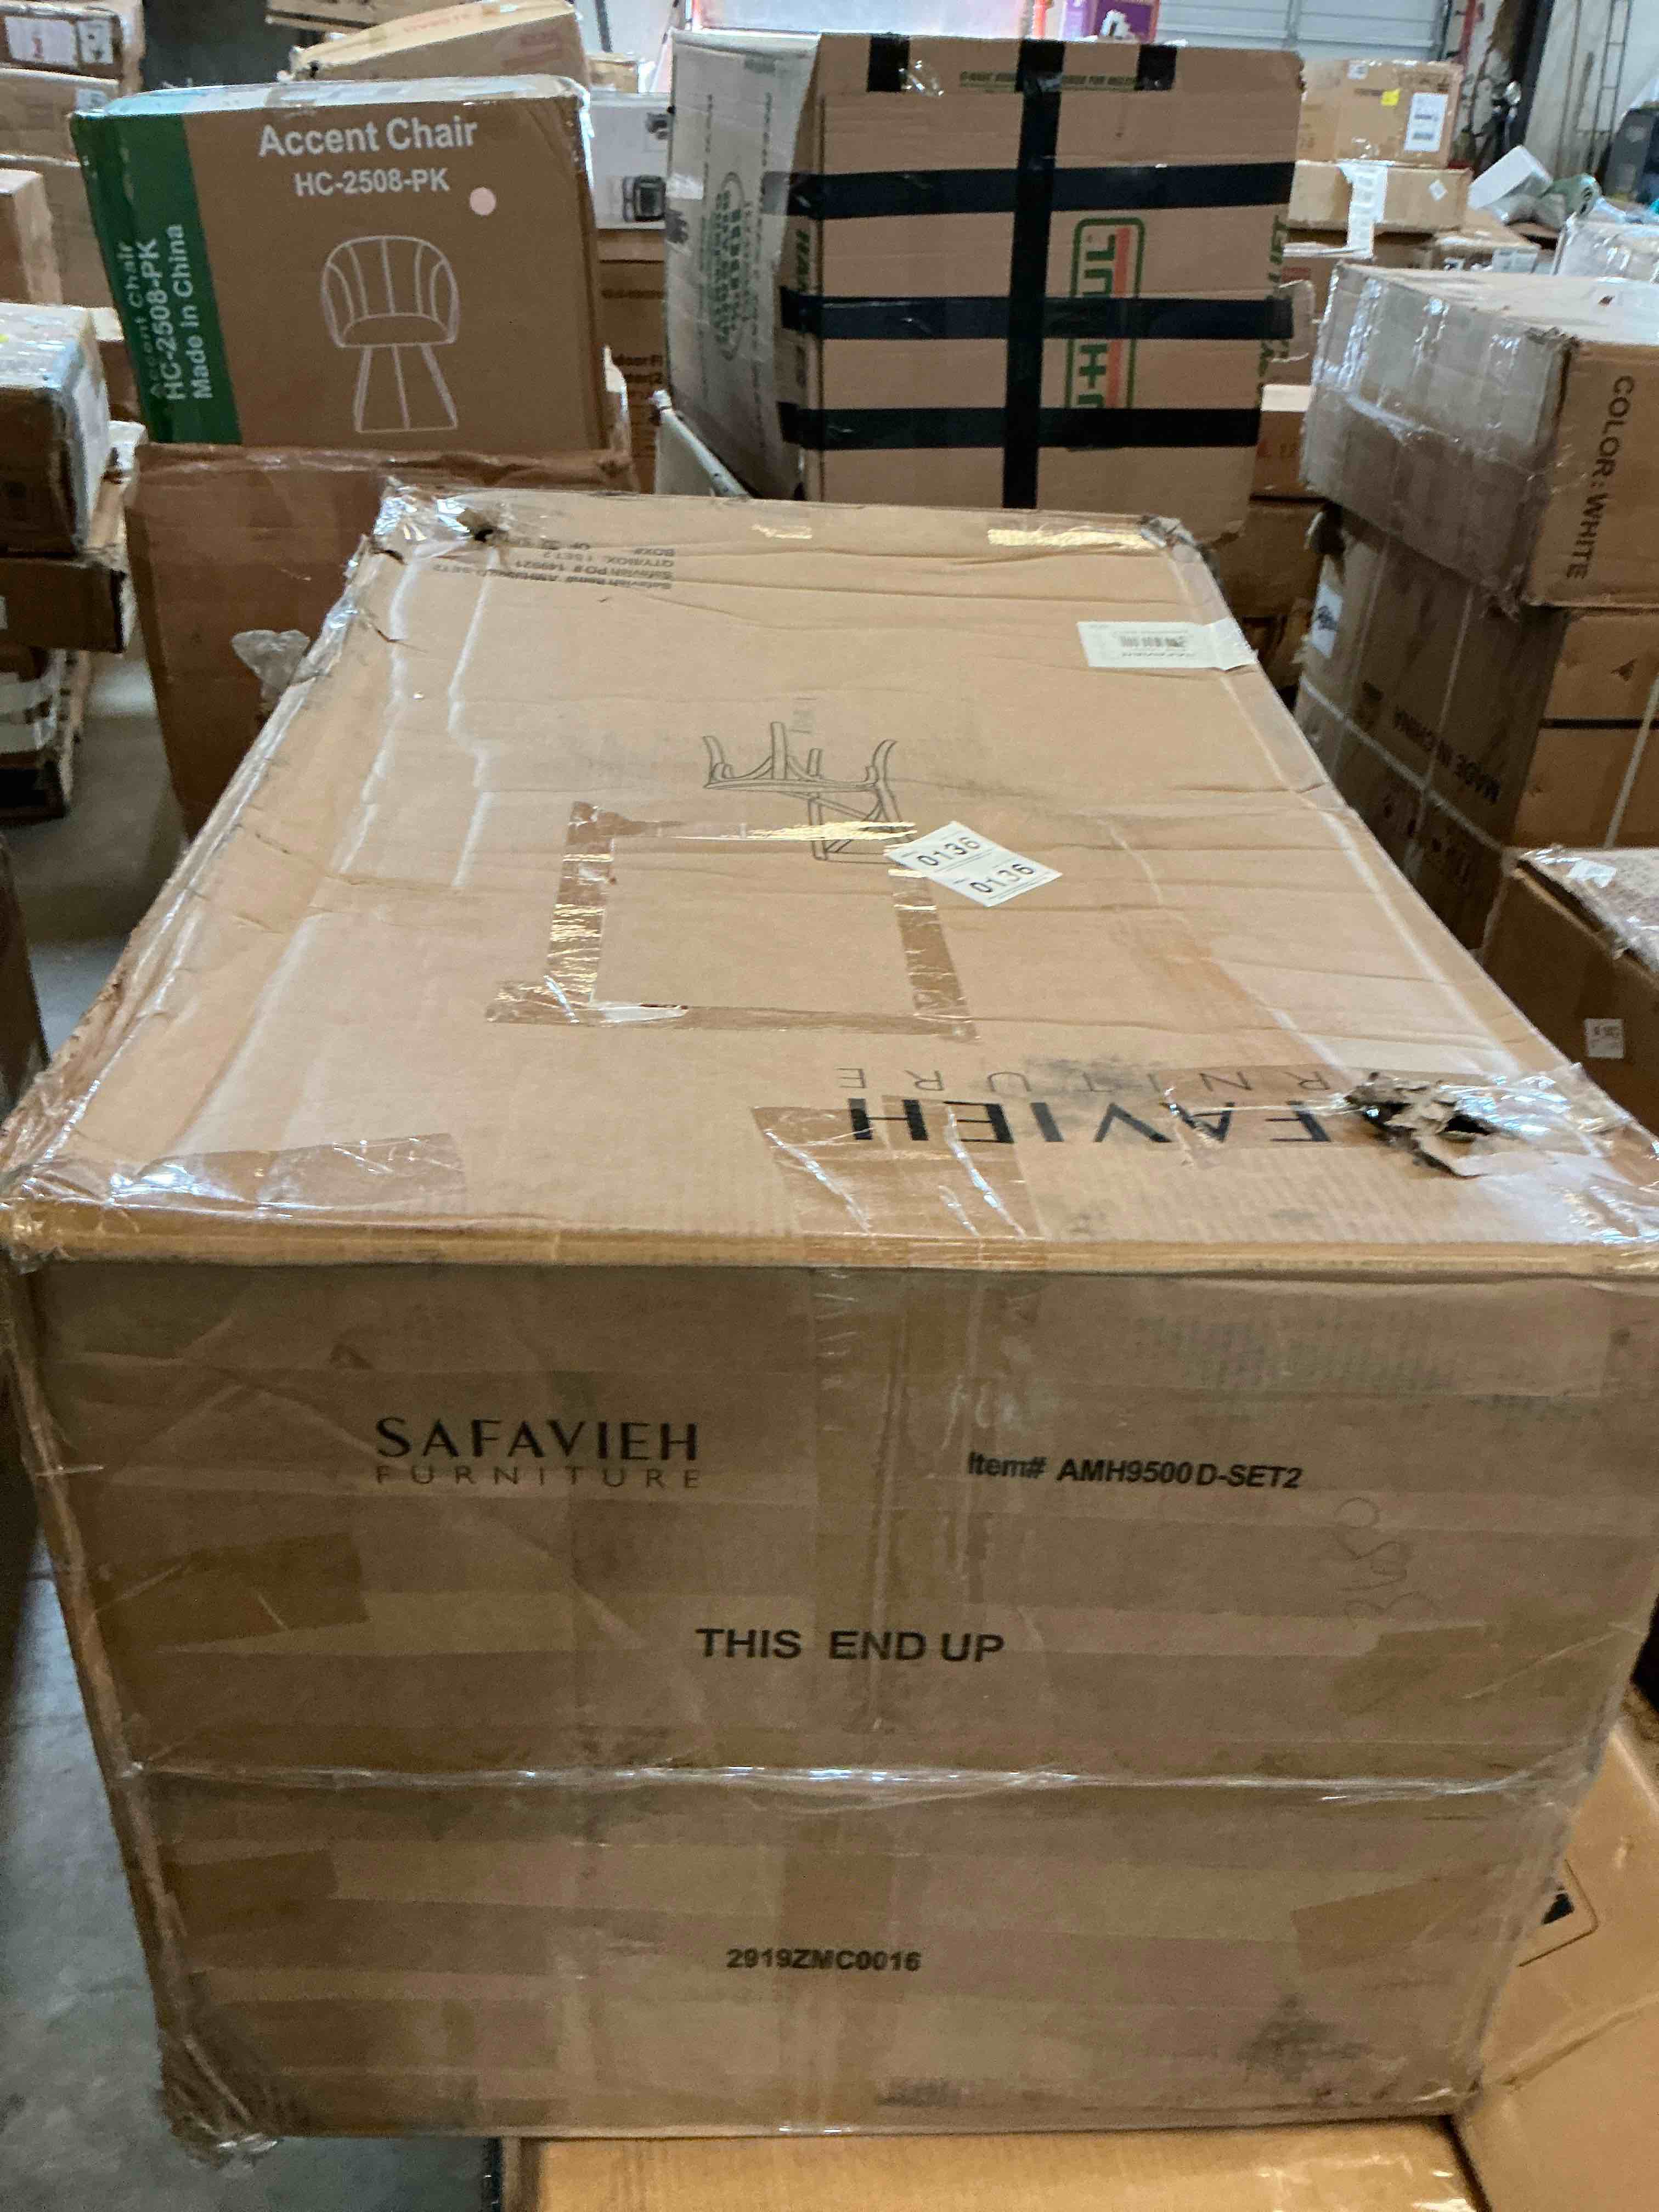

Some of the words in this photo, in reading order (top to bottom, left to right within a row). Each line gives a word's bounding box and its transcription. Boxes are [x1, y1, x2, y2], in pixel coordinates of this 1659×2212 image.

[258, 121, 380, 158] Accent
[386, 115, 478, 150] Chair
[294, 167, 450, 197] HC-2508-PK
[116, 240, 144, 308] Chair
[167, 224, 193, 298] China
[136, 238, 187, 401] HC-2508-PK
[185, 335, 214, 399] Made
[917, 837, 980, 866] 0136
[970, 864, 1034, 893] 0136
[376, 1418, 697, 1460] SAFAVIEH
[376, 1465, 703, 1488] FURNITURE
[968, 1451, 1047, 1479] Item#
[695, 1628, 802, 1659] THIS
[828, 1630, 927, 1661] END
[941, 1632, 1005, 1663] UP
